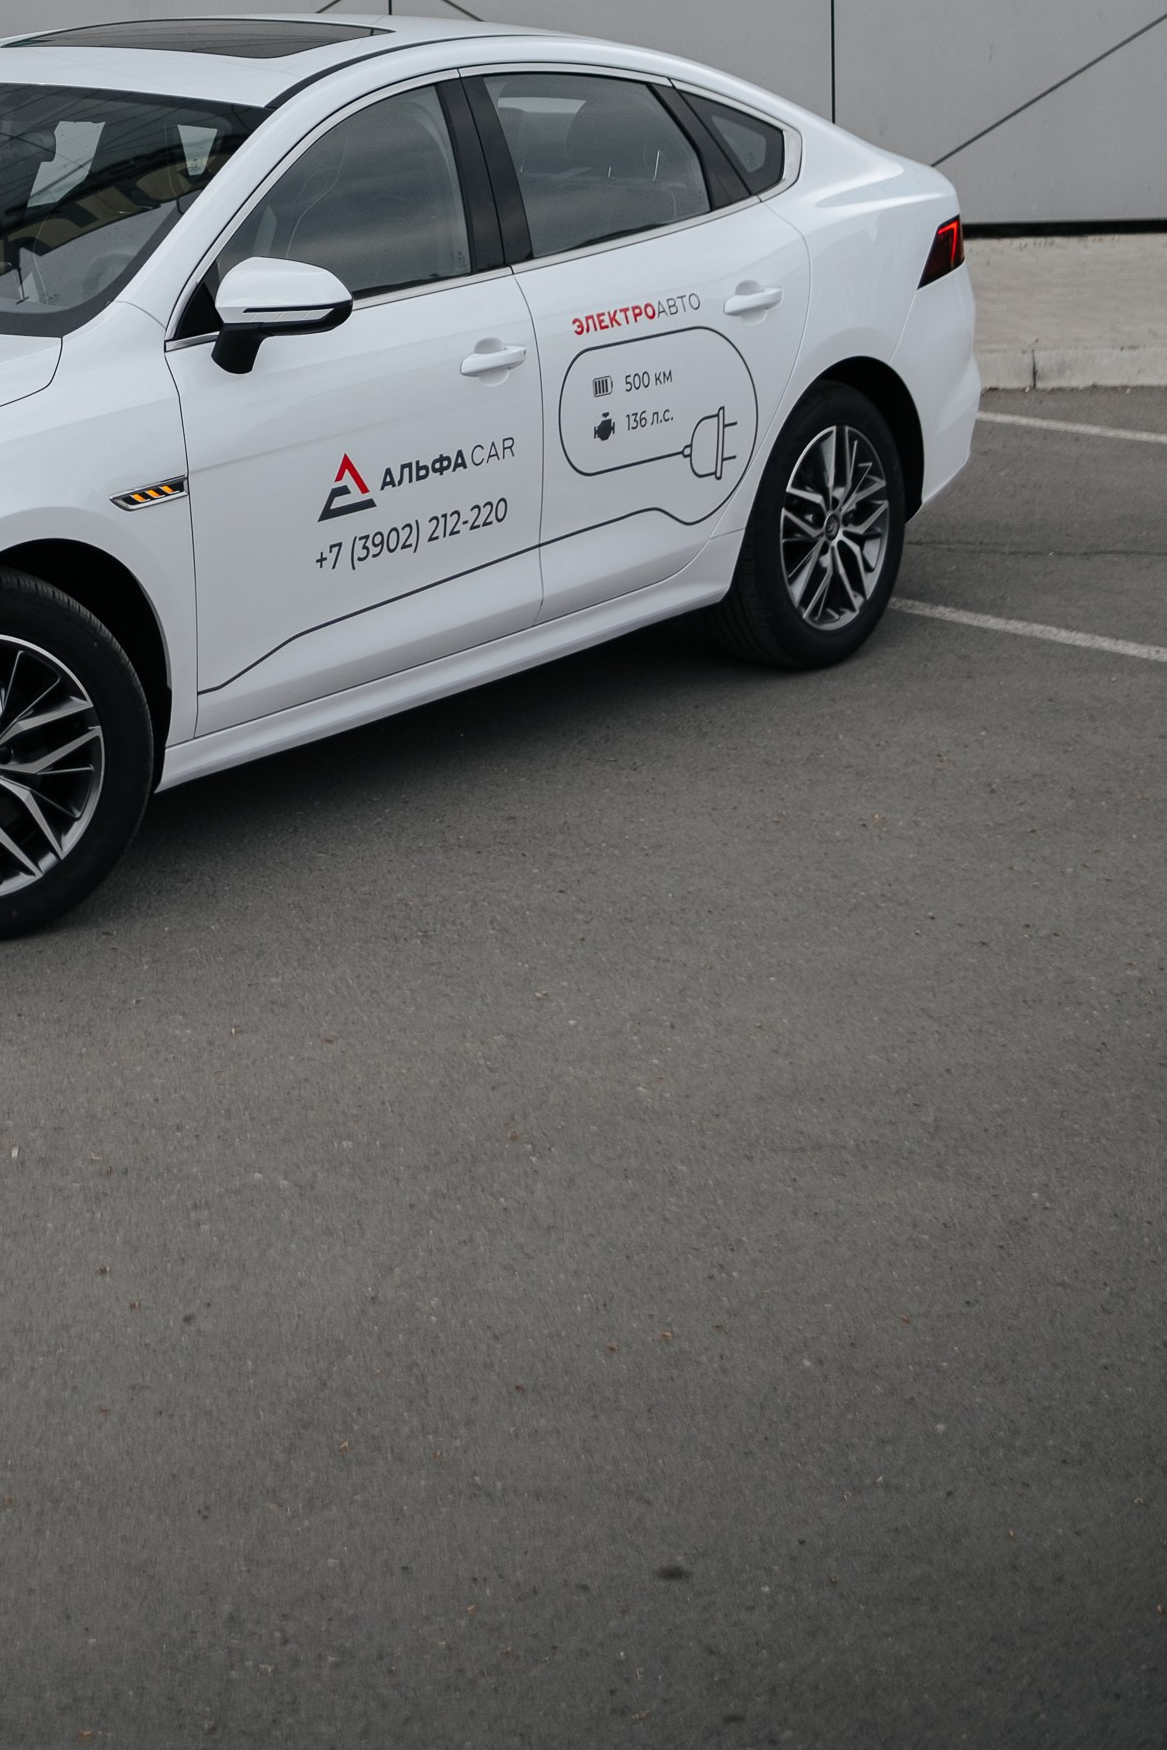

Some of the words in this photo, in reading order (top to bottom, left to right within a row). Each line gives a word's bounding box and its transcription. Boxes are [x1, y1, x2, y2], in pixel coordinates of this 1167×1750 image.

[571, 292, 701, 336] ЭЛЕКТРОАВТО
[624, 371, 651, 392] 500
[625, 410, 648, 431] 136
[650, 409, 674, 427] л.с.
[315, 541, 343, 570] +7
[350, 519, 420, 570] (3902)
[427, 497, 508, 543] 212-220
